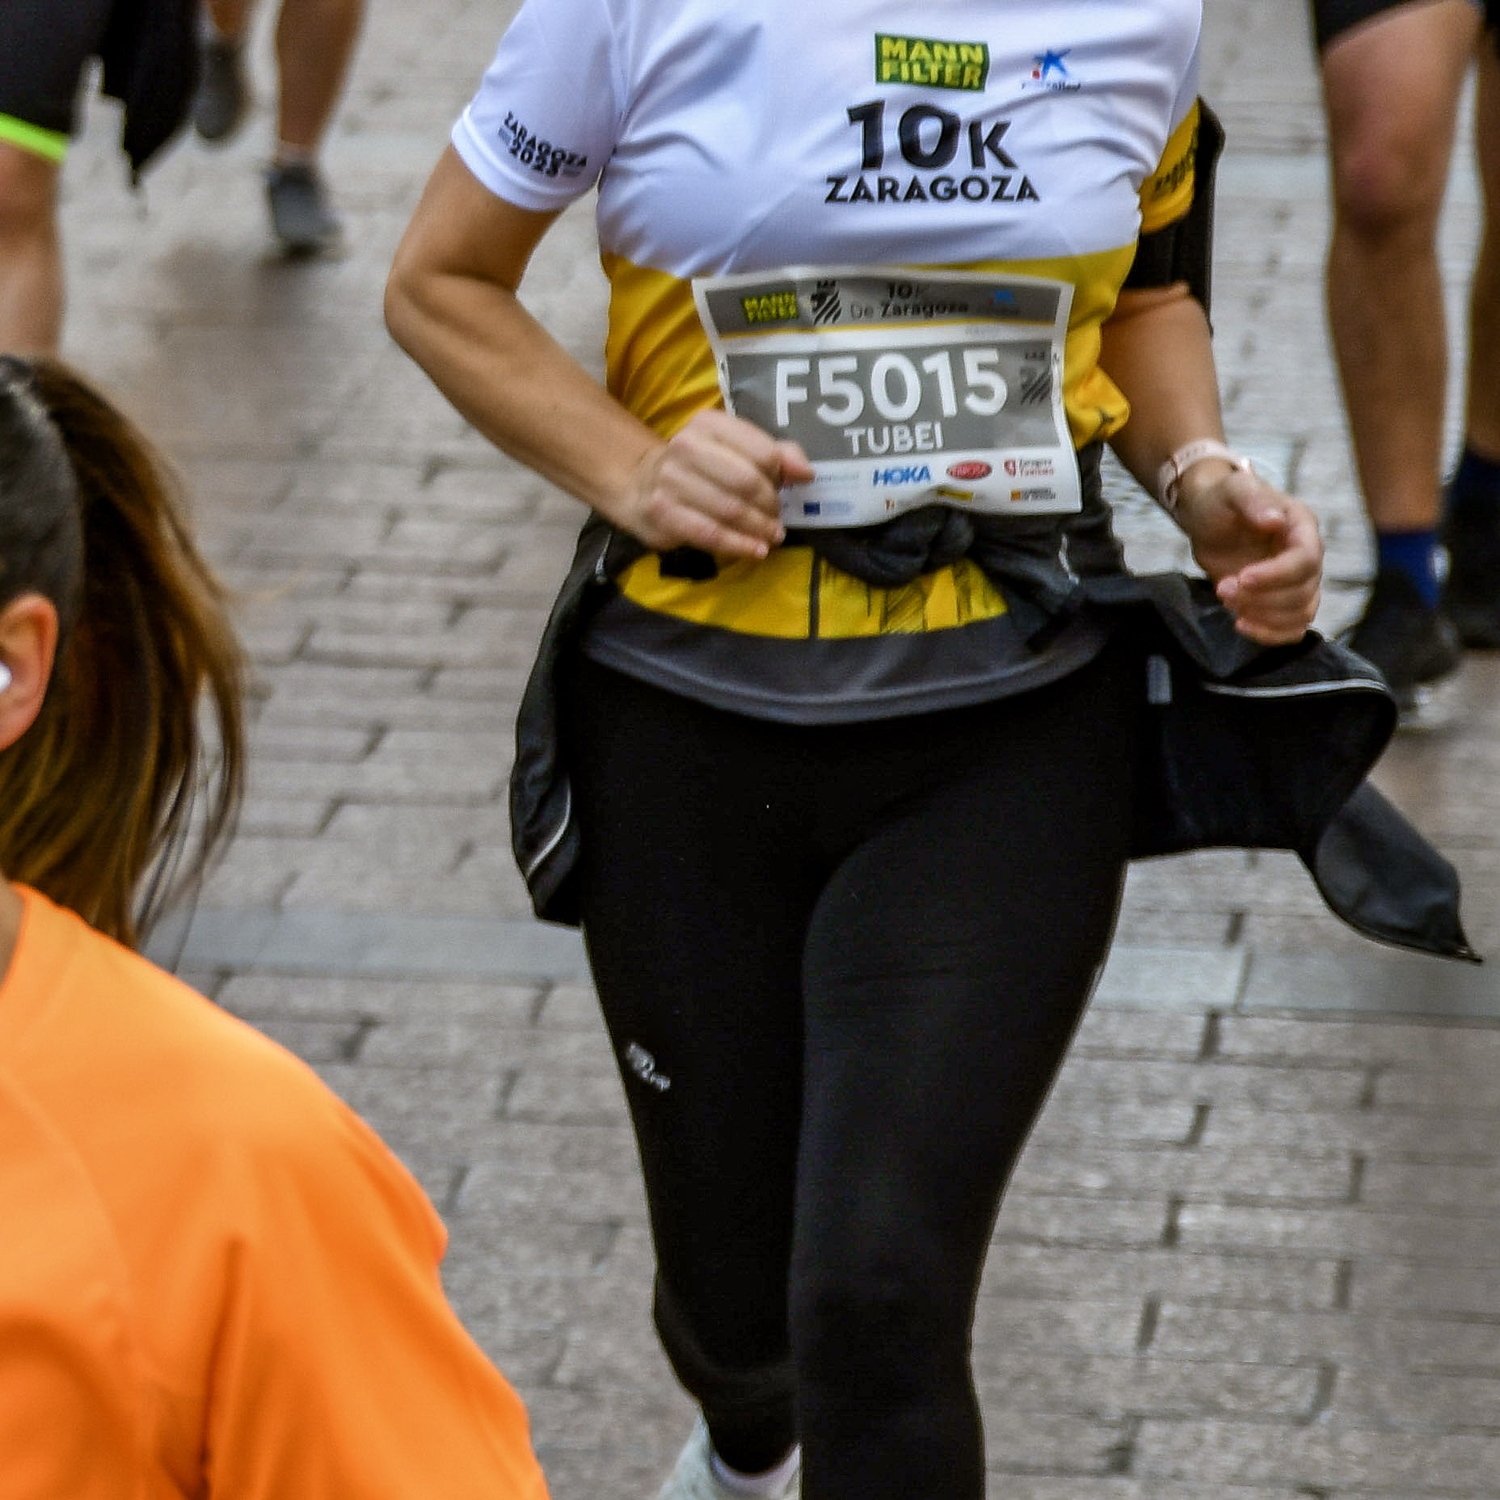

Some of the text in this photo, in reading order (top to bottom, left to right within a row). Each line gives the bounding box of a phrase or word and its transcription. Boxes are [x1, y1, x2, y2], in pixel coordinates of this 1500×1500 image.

[881, 37, 984, 63] MANN
[881, 61, 982, 89] FILTER
[503, 111, 588, 168] ZARAGOZA
[847, 100, 1018, 170] 10K
[509, 136, 561, 178] 2023
[824, 174, 1041, 203] ZARAGOZA
[880, 300, 969, 319] Zaragoza
[775, 347, 1009, 428] F5015
[843, 421, 945, 456] TUBEI
[872, 463, 933, 487] HOKA
